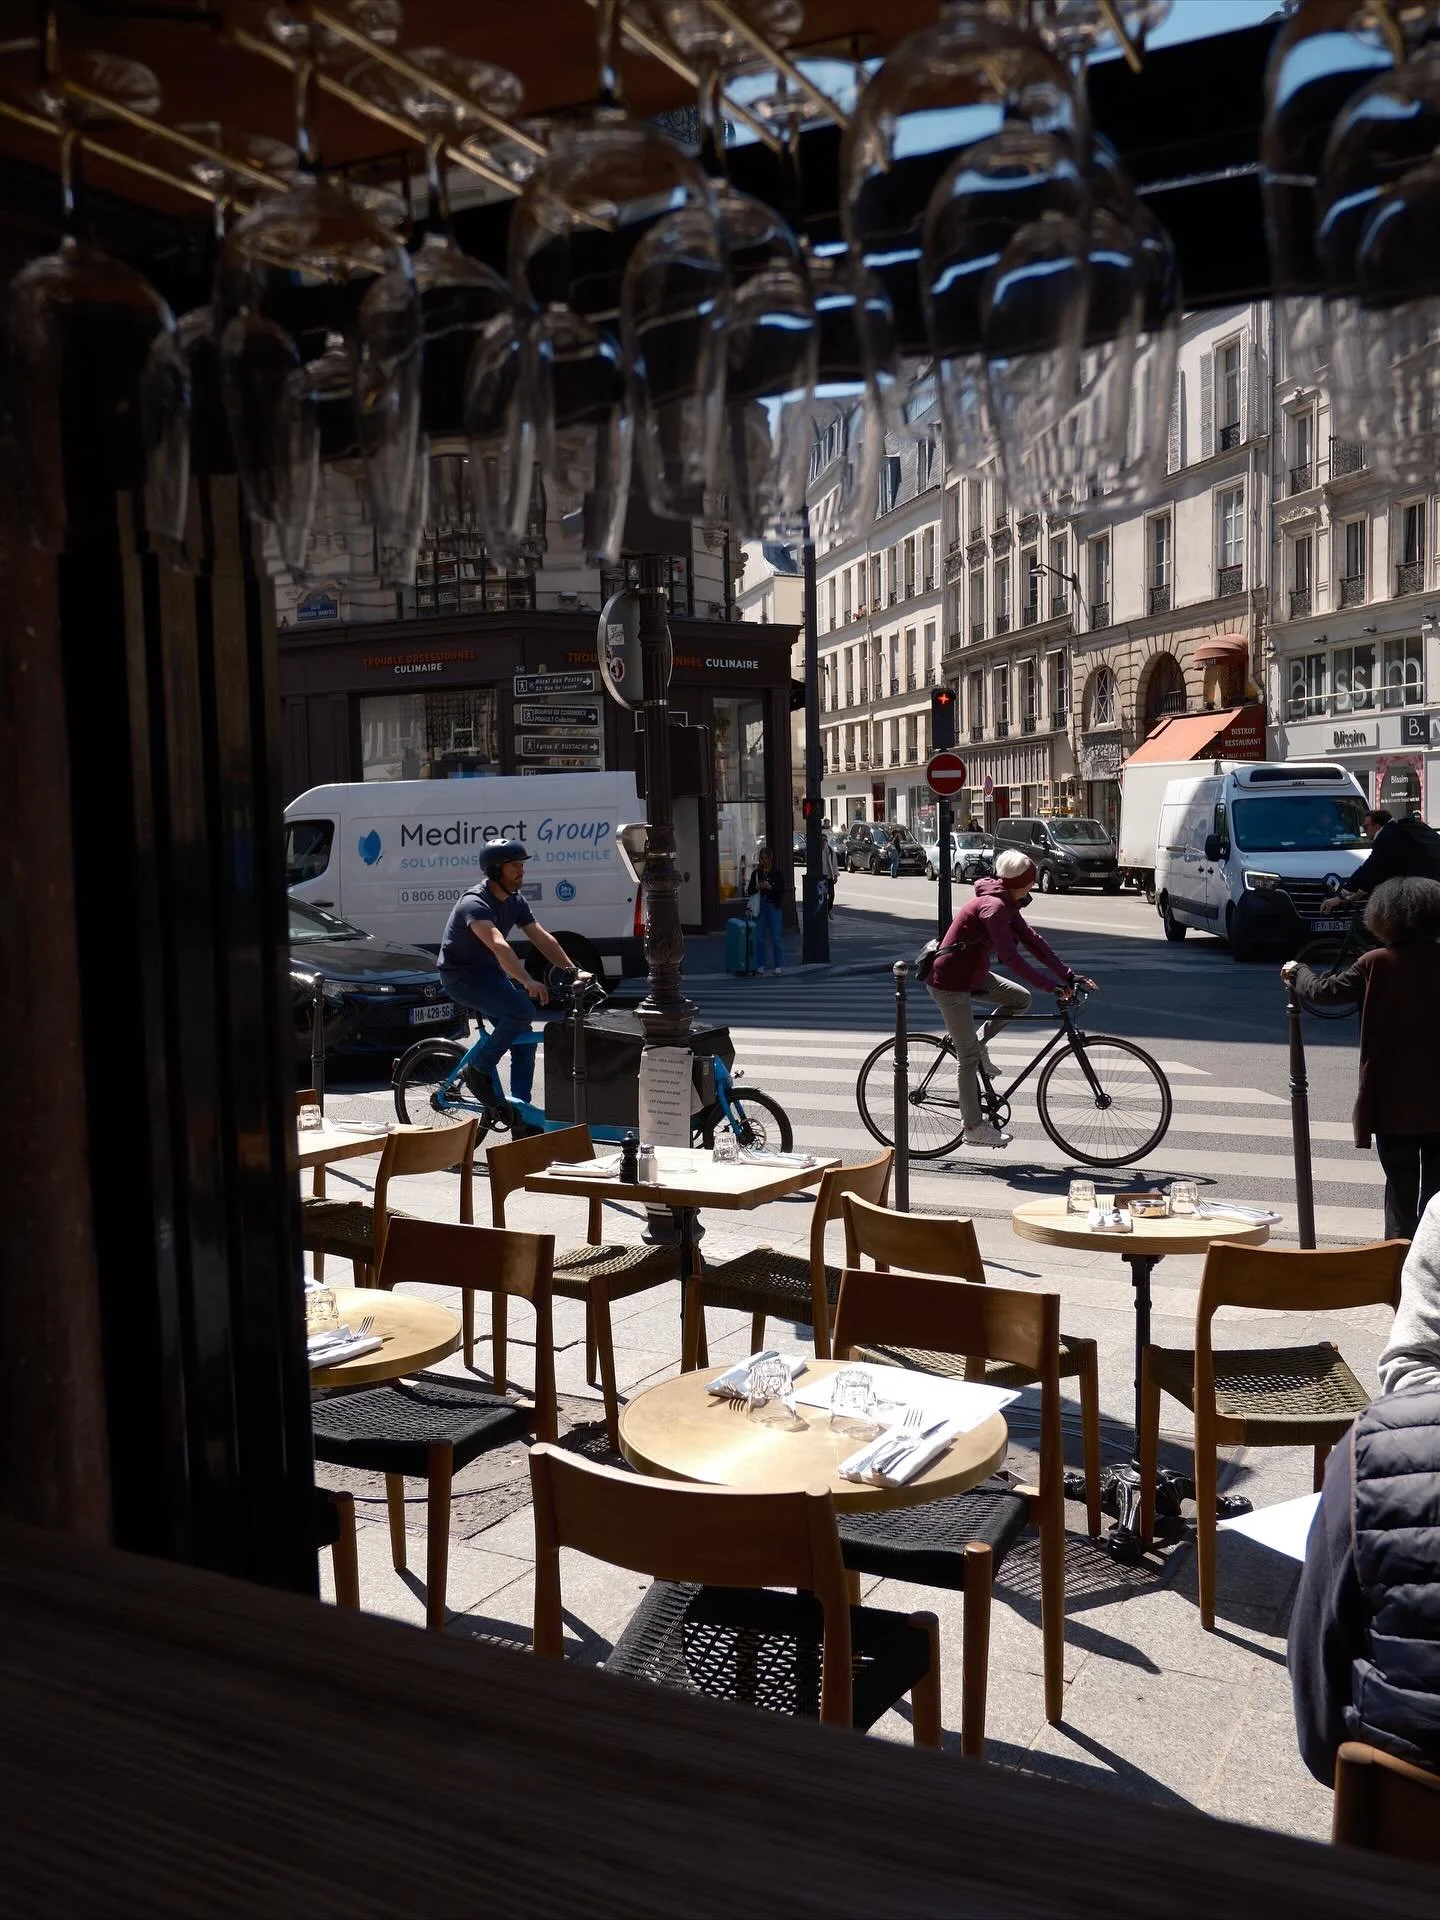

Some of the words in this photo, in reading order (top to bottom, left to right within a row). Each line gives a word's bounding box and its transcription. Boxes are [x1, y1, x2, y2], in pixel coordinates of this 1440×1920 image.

[394, 663, 442, 673] CULINAIRE
[567, 652, 597, 663] TROU
[706, 658, 759, 669] CULINAIRE
[400, 820, 527, 847] Medirect
[536, 818, 611, 846] Group
[400, 856, 478, 869] SOLUTIONS
[546, 850, 611, 863] DOMICILE
[401, 890, 409, 901] 0
[412, 890, 435, 901] 806
[438, 890, 460, 901] 800
